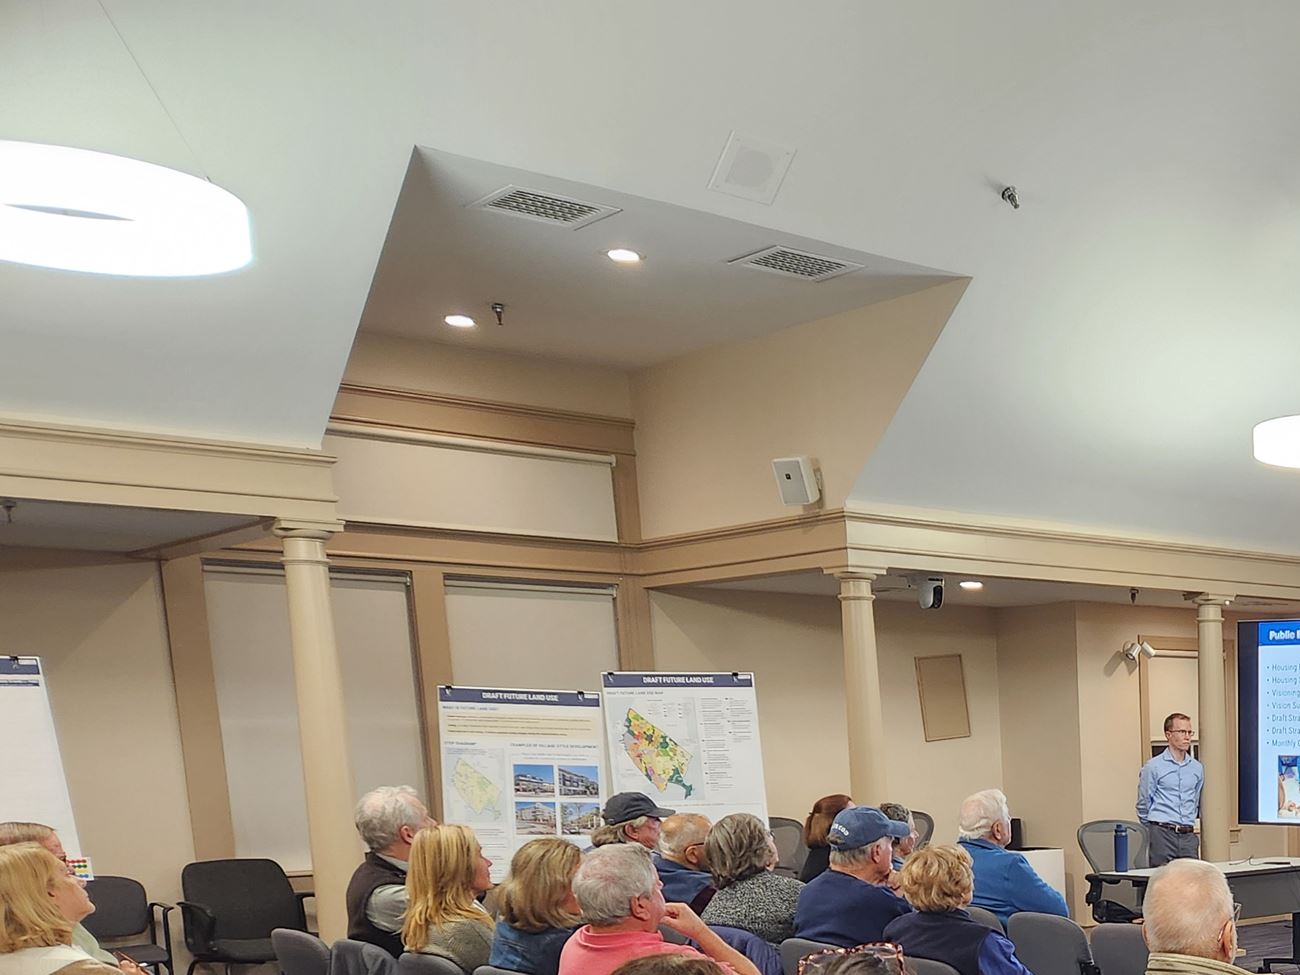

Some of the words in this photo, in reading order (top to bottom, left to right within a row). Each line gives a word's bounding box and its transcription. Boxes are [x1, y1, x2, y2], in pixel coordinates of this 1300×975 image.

[1269, 630, 1296, 641] Public
[1271, 663, 1297, 673] Housing
[642, 676, 663, 684] DRAFT
[662, 676, 686, 684] FUTURE
[685, 676, 702, 684] LAND
[701, 676, 715, 684] USE
[1271, 676, 1297, 685] Housing
[481, 692, 503, 700] DRAFT
[503, 693, 528, 701] FUTURE
[545, 694, 559, 702] USE
[1271, 688, 1300, 698] Visioning
[1271, 701, 1291, 709] Vision
[1271, 713, 1288, 722] Draft
[1271, 726, 1288, 735] Draft
